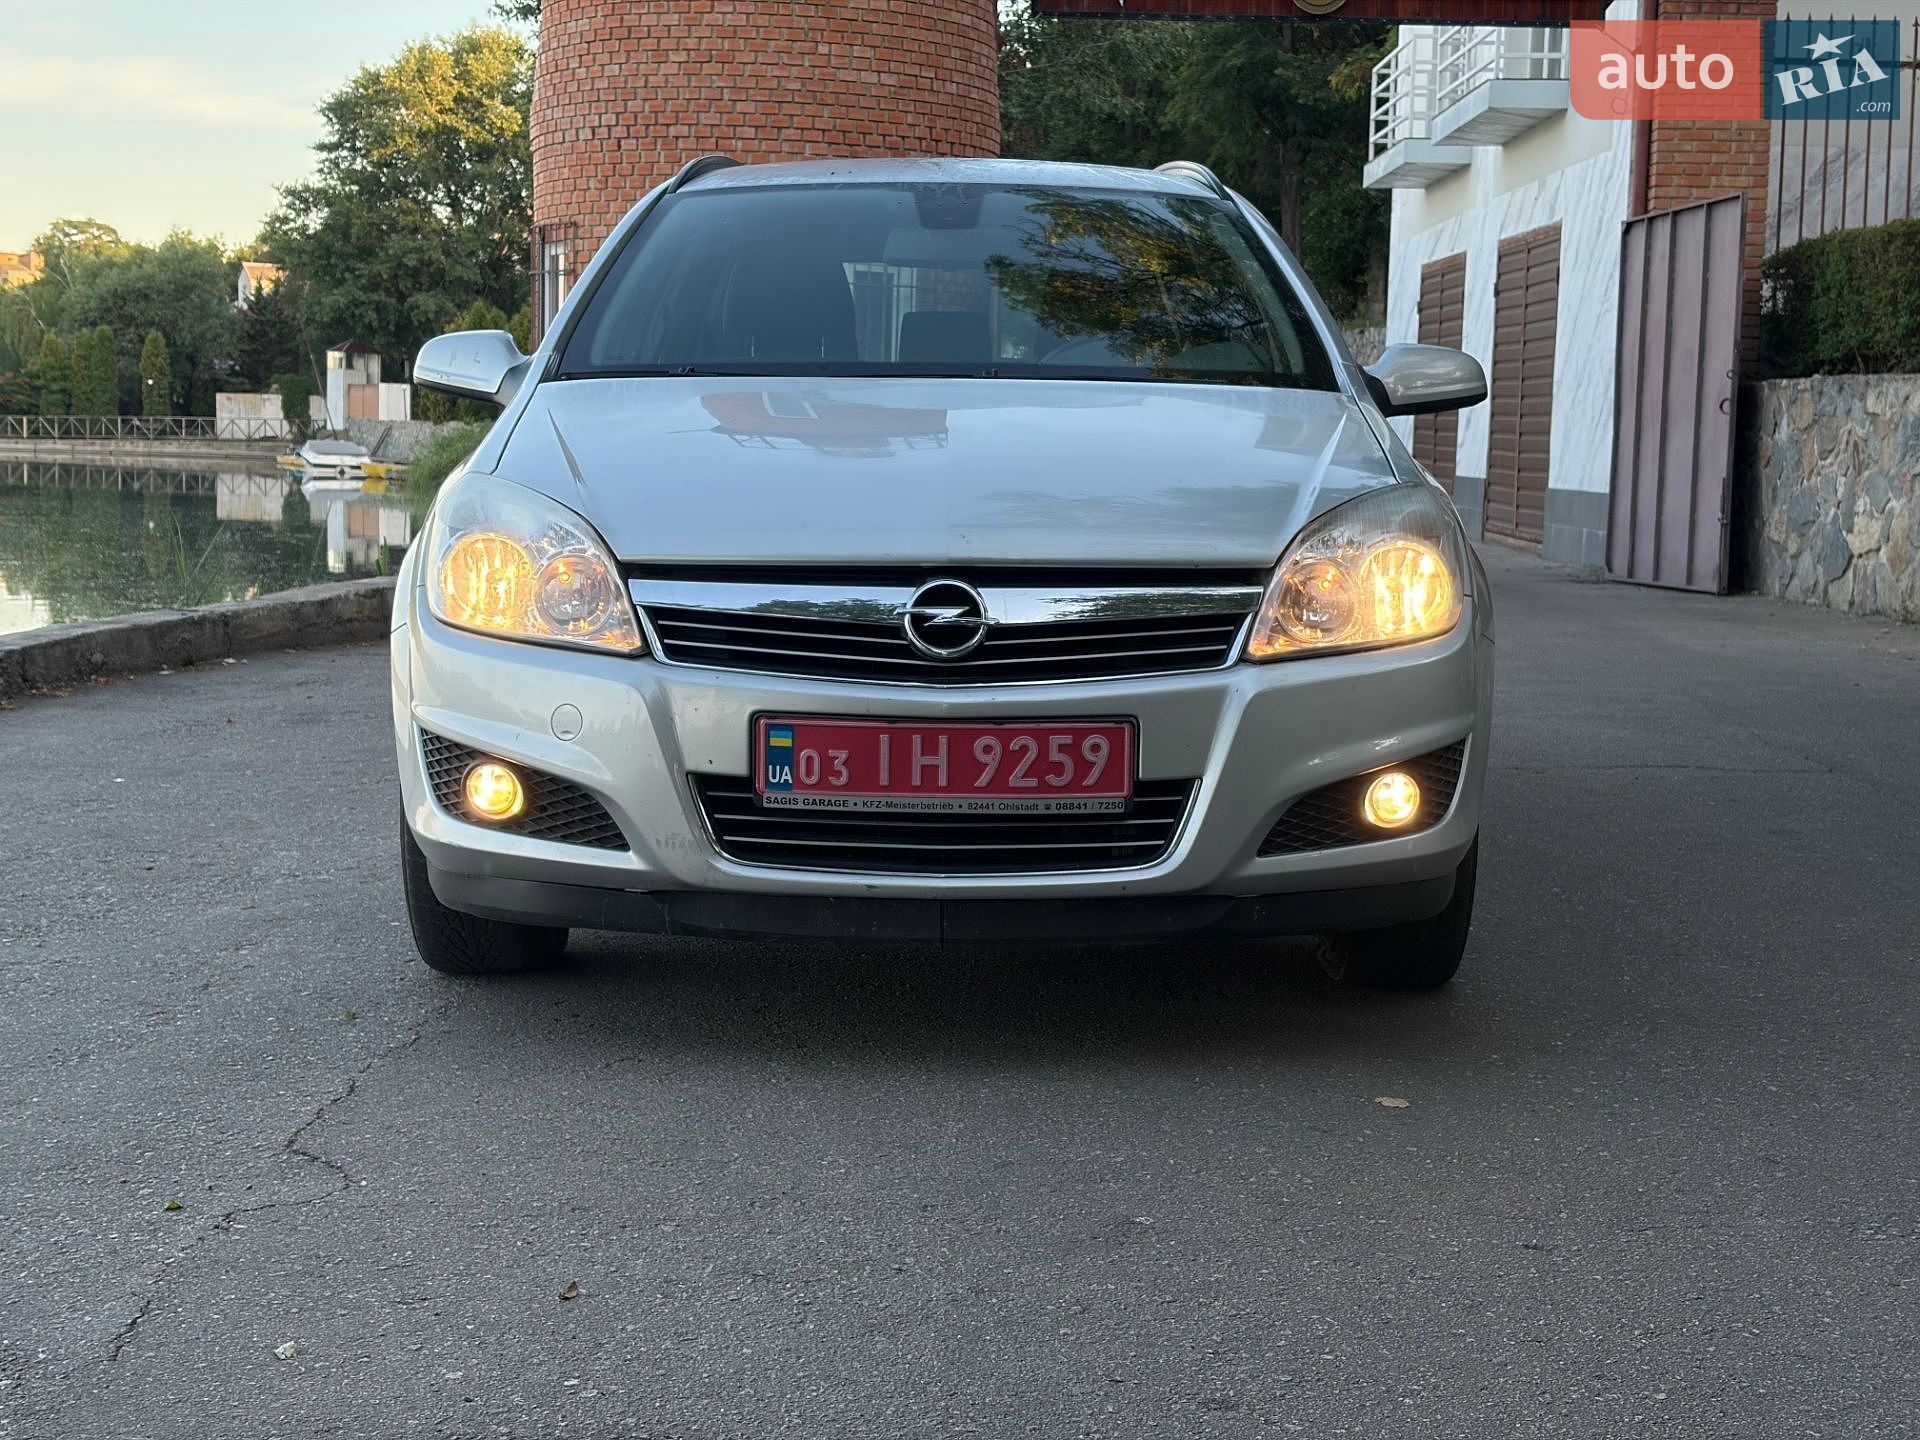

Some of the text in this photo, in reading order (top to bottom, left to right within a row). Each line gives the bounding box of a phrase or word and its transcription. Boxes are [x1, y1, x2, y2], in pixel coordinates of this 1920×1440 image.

[800, 749, 850, 786] 03
[973, 735, 1110, 788] 9259
[768, 765, 793, 784] UA
[765, 796, 800, 806] SAGIS
[802, 798, 849, 808] GARAGE
[862, 800, 954, 811] KFZ-Meisterbetrieb
[967, 802, 995, 811] 82441
[999, 802, 1039, 811] Ohlstadt
[1055, 801, 1088, 811] 08841
[1098, 801, 1124, 810] 7250
